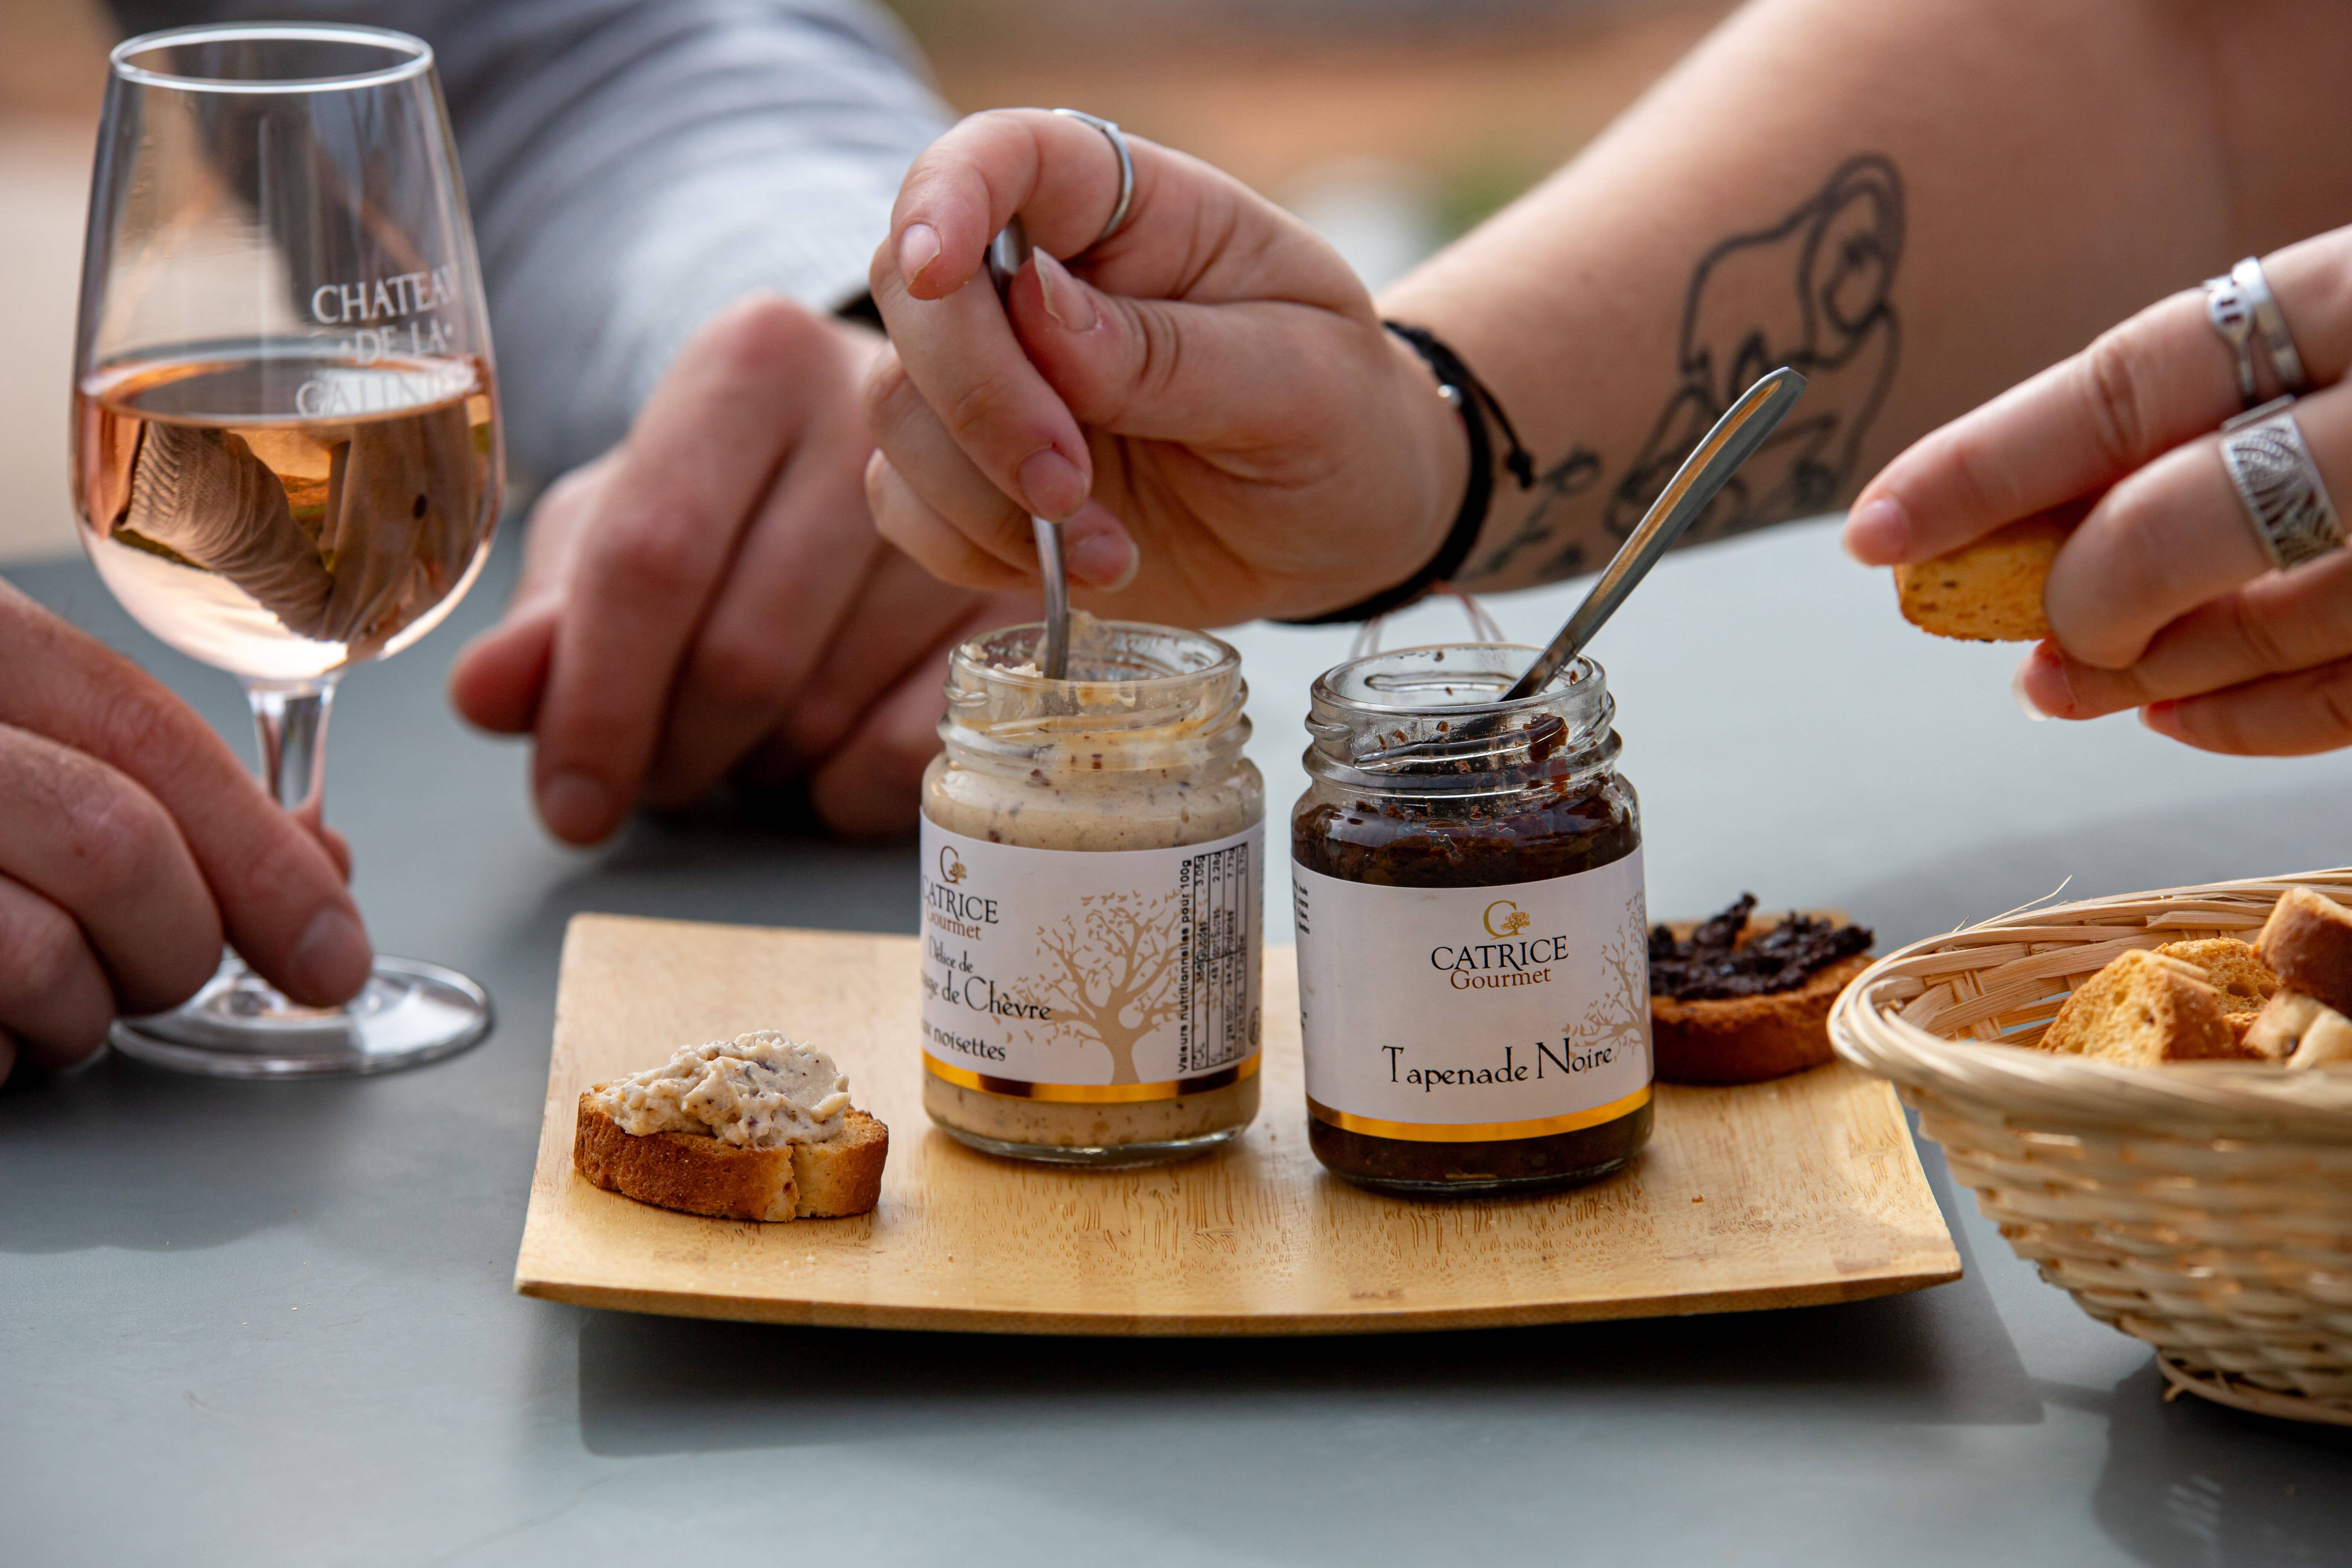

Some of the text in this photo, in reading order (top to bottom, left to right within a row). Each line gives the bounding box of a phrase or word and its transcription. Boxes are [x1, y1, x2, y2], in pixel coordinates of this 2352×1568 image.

[355, 325, 398, 365] DE
[1180, 859, 1192, 889] 100g
[1182, 894, 1191, 923] pour
[959, 950, 974, 974] de
[1431, 935, 1569, 971] CATRICE
[942, 969, 960, 1005] de
[965, 975, 1052, 1021] Chèvre
[1450, 967, 1552, 990] Gourmet
[934, 1027, 1006, 1062] noisettes
[1178, 1024, 1188, 1073] Valeurs
[1381, 1037, 1613, 1093] Tapenade Noire
